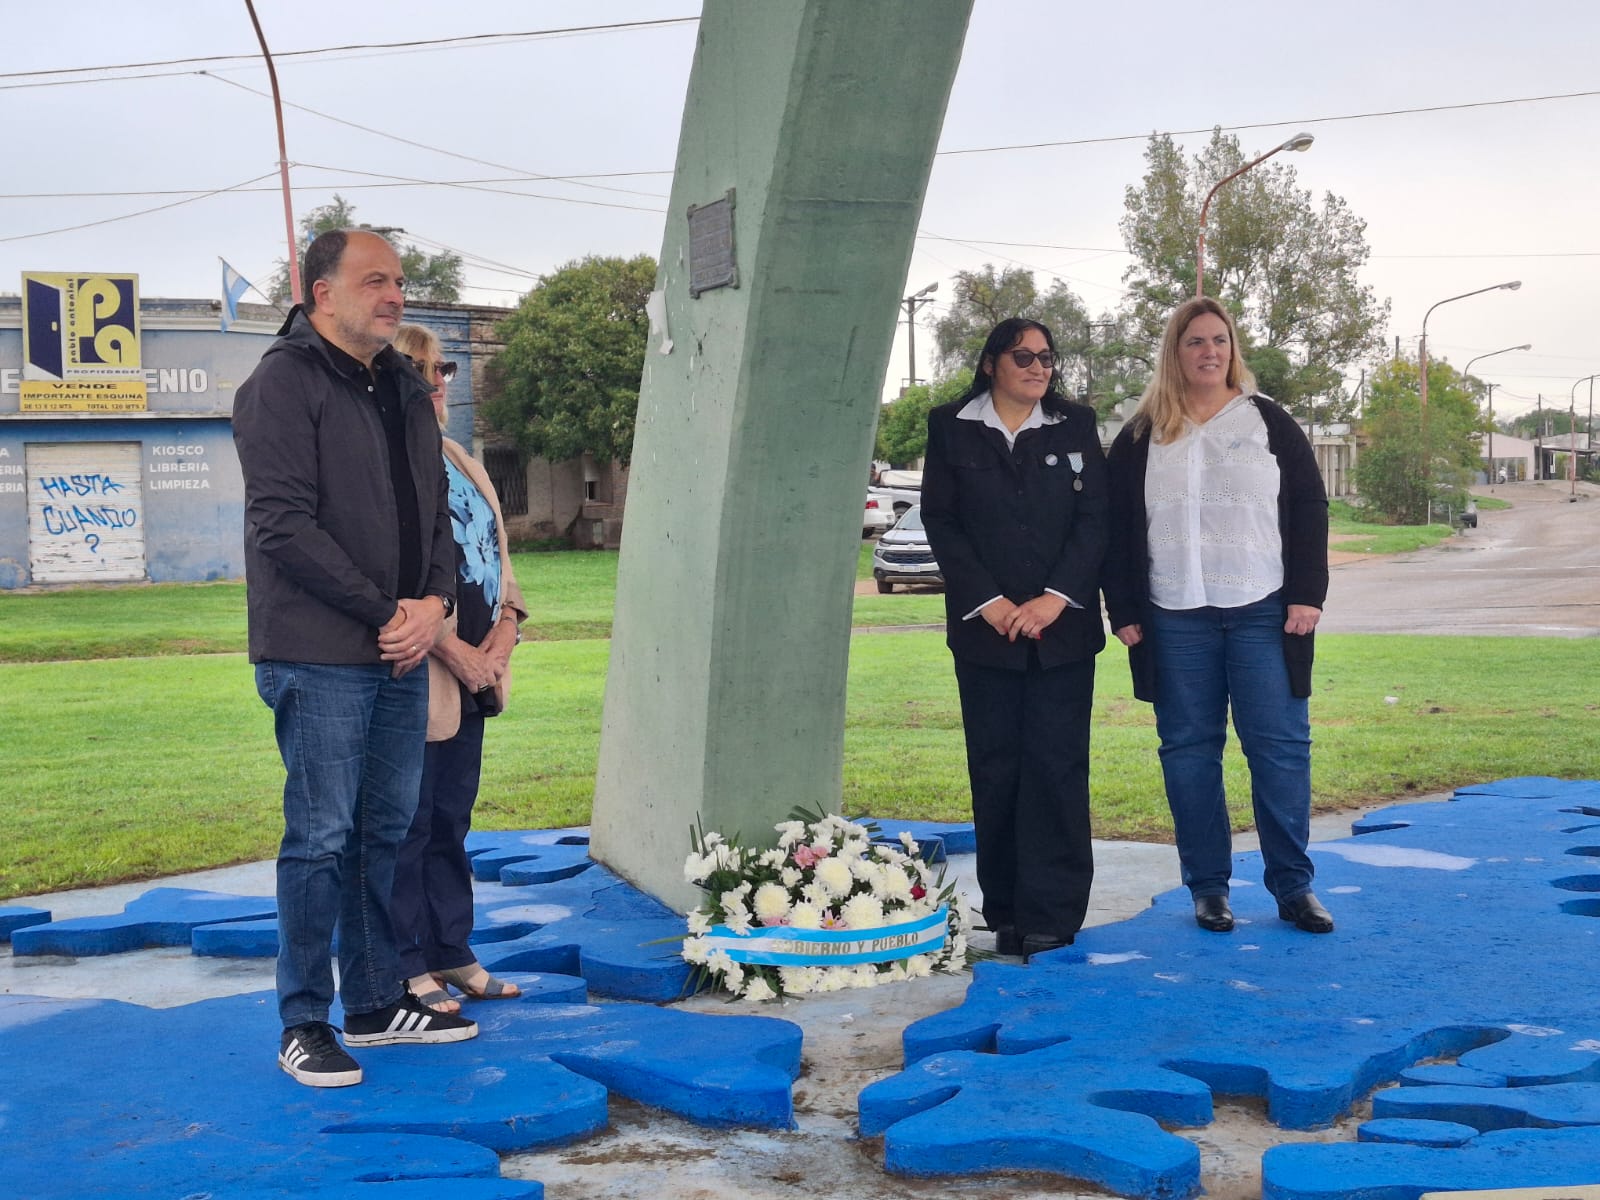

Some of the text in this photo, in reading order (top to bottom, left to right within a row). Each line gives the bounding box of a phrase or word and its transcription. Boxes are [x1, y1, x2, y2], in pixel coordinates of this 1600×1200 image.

[69, 331, 79, 364] pablo
[145, 368, 208, 393] ENIO
[152, 445, 204, 456] KIOSCO
[150, 462, 210, 473] LIBRERIA
[39, 474, 126, 500] HASTA
[150, 479, 211, 490] LIMPIEZA
[42, 505, 136, 535] CUANDO
[857, 941, 865, 954] Y
[871, 931, 919, 953] PUEBLO
